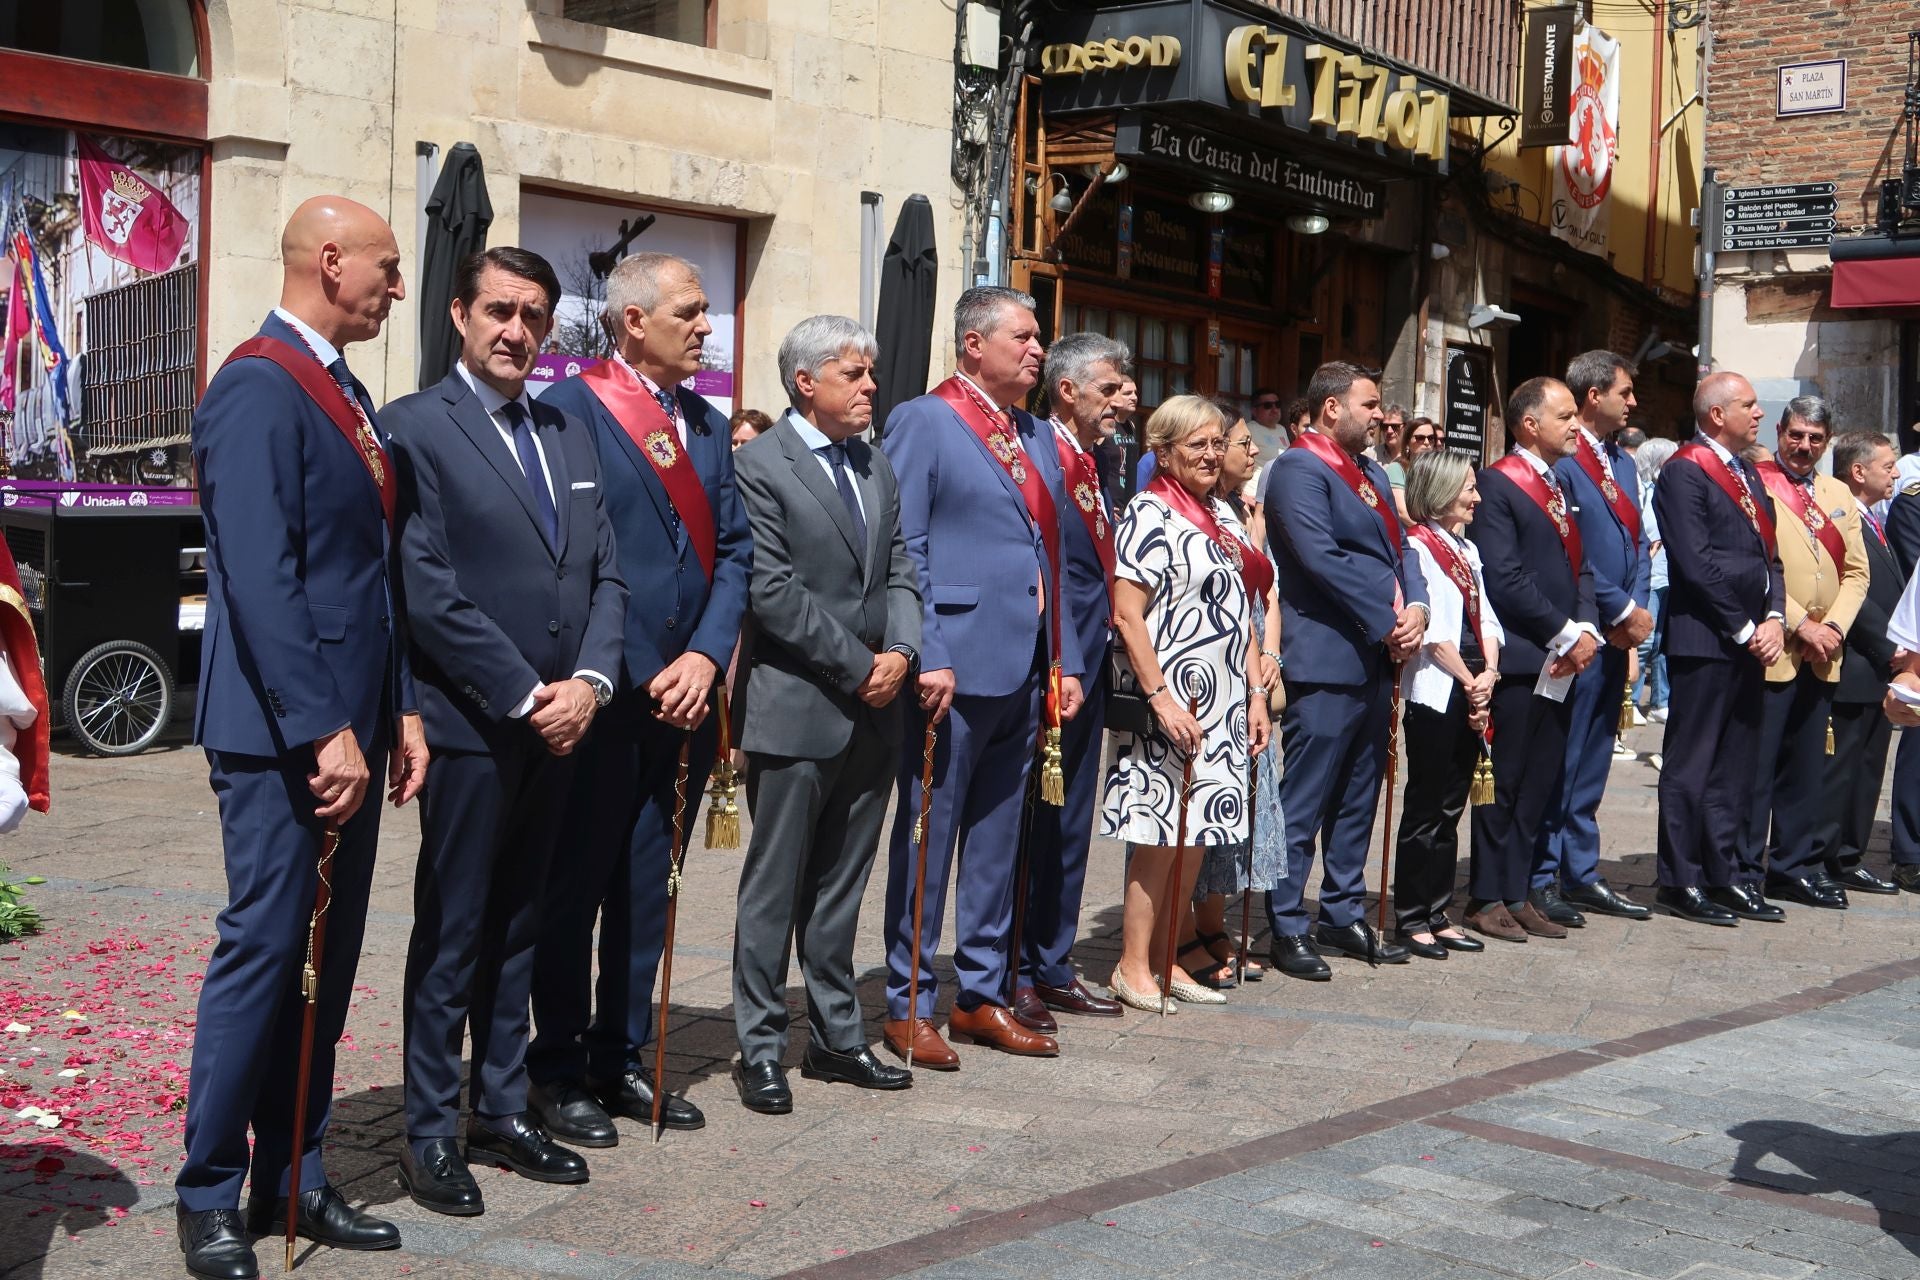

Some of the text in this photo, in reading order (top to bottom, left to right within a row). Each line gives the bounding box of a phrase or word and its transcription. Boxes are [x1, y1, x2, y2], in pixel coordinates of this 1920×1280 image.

[1543, 24, 1556, 109] RESTAURANTE
[1802, 72, 1824, 83] PLAZA
[1790, 87, 1833, 102] SAN MARTÍN
[1151, 122, 1375, 209] La Casa del Embutido
[1738, 190, 1760, 198] Iglesia
[1775, 187, 1796, 195] Martín
[1738, 204, 1762, 212] Balcón
[1775, 202, 1798, 210] Pueblo
[1783, 208, 1806, 216] ciudad
[1757, 224, 1778, 232] Mayor
